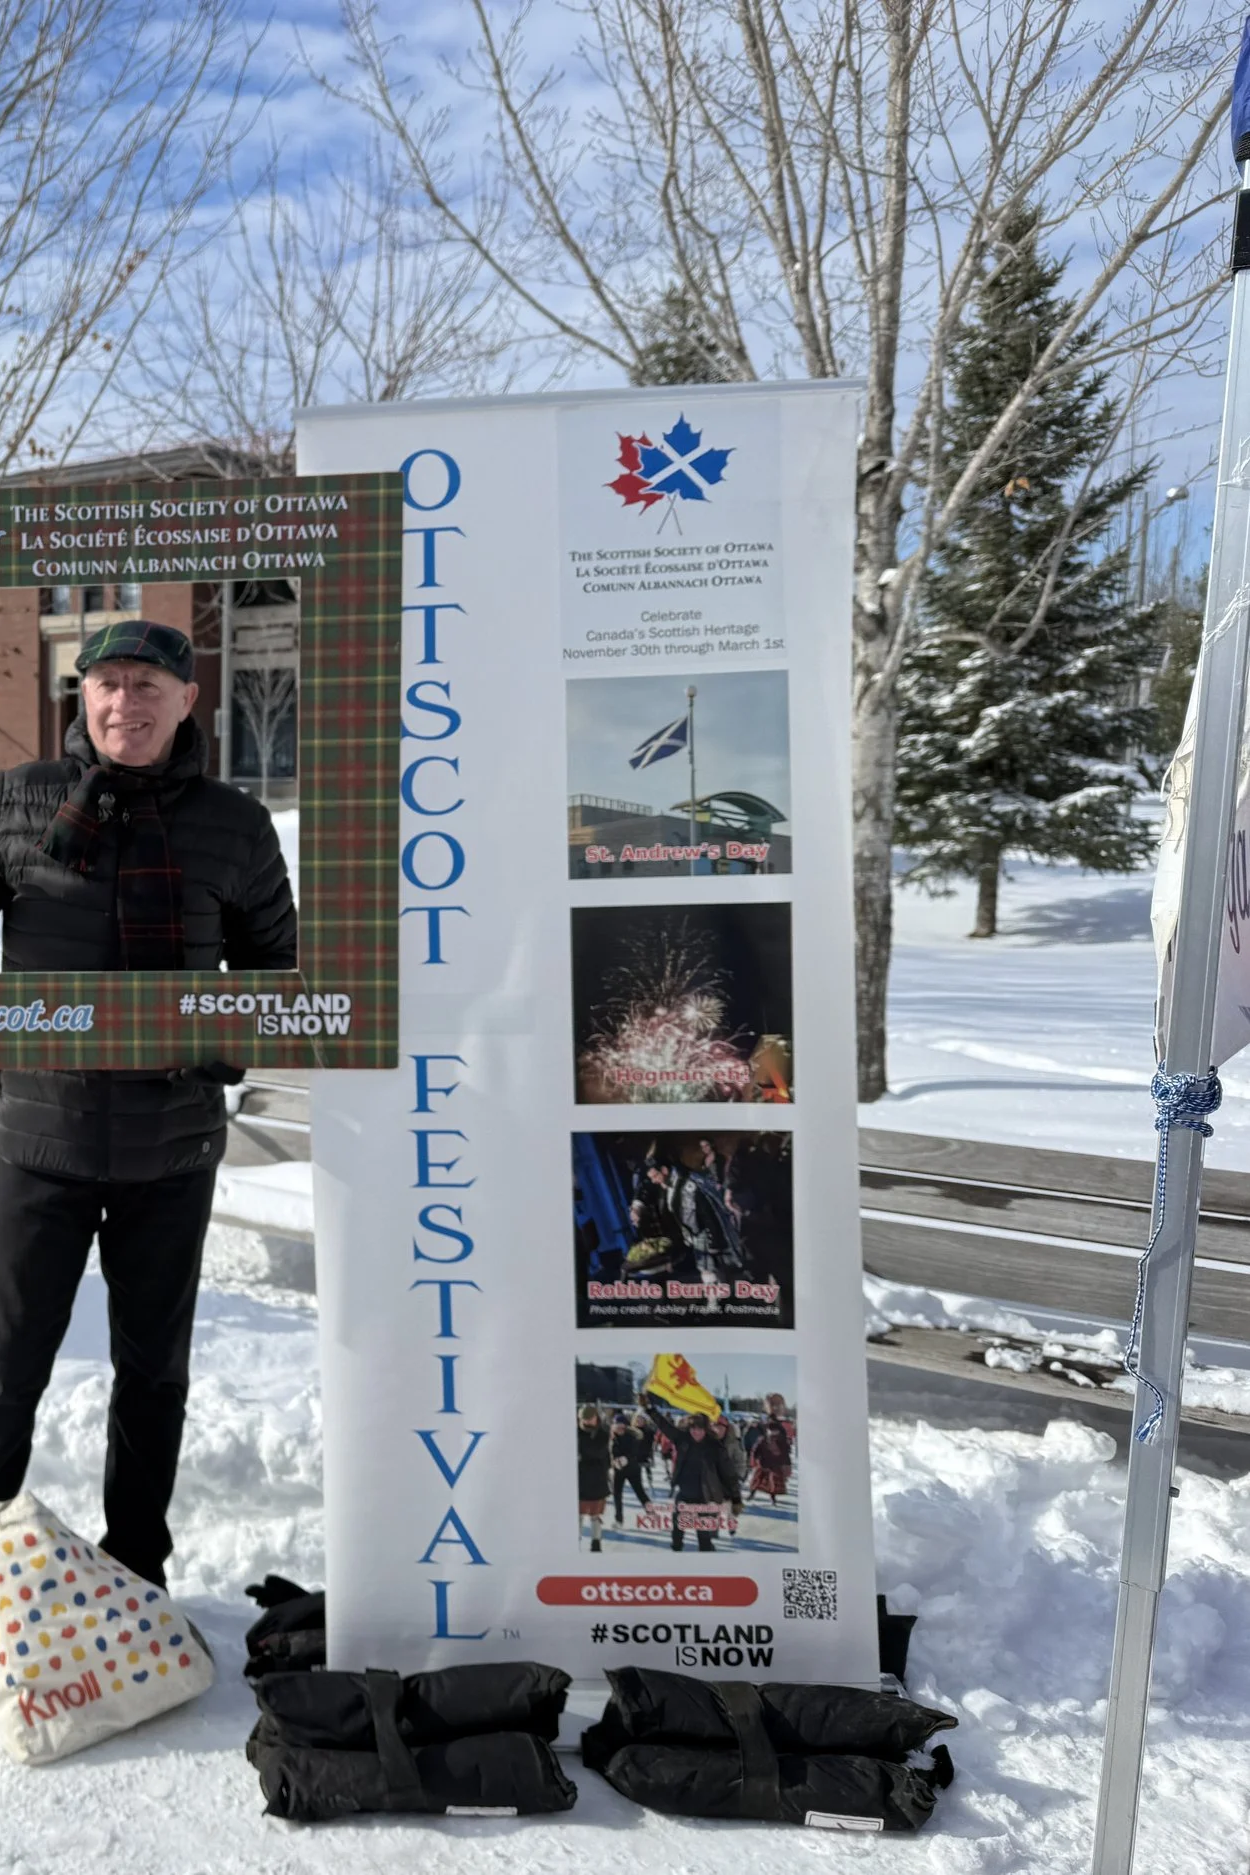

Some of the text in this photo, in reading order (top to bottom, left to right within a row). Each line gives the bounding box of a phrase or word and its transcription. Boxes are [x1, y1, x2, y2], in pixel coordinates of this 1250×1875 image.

[640, 609, 703, 623] Celebrate
[586, 622, 761, 642] Canada's Scottish Heritage
[562, 637, 786, 660] November 30th through March 1st
[584, 840, 771, 864] St. Andrew's Day
[179, 993, 352, 1015] #SCOTLAND
[587, 1279, 780, 1303] Robbie Burns Day
[408, 1054, 493, 1641] FESTIVAL
[581, 1582, 713, 1602] ottscot.ca
[591, 1623, 774, 1645] #SCOTLAND
[18, 1669, 102, 1728] Knoll
